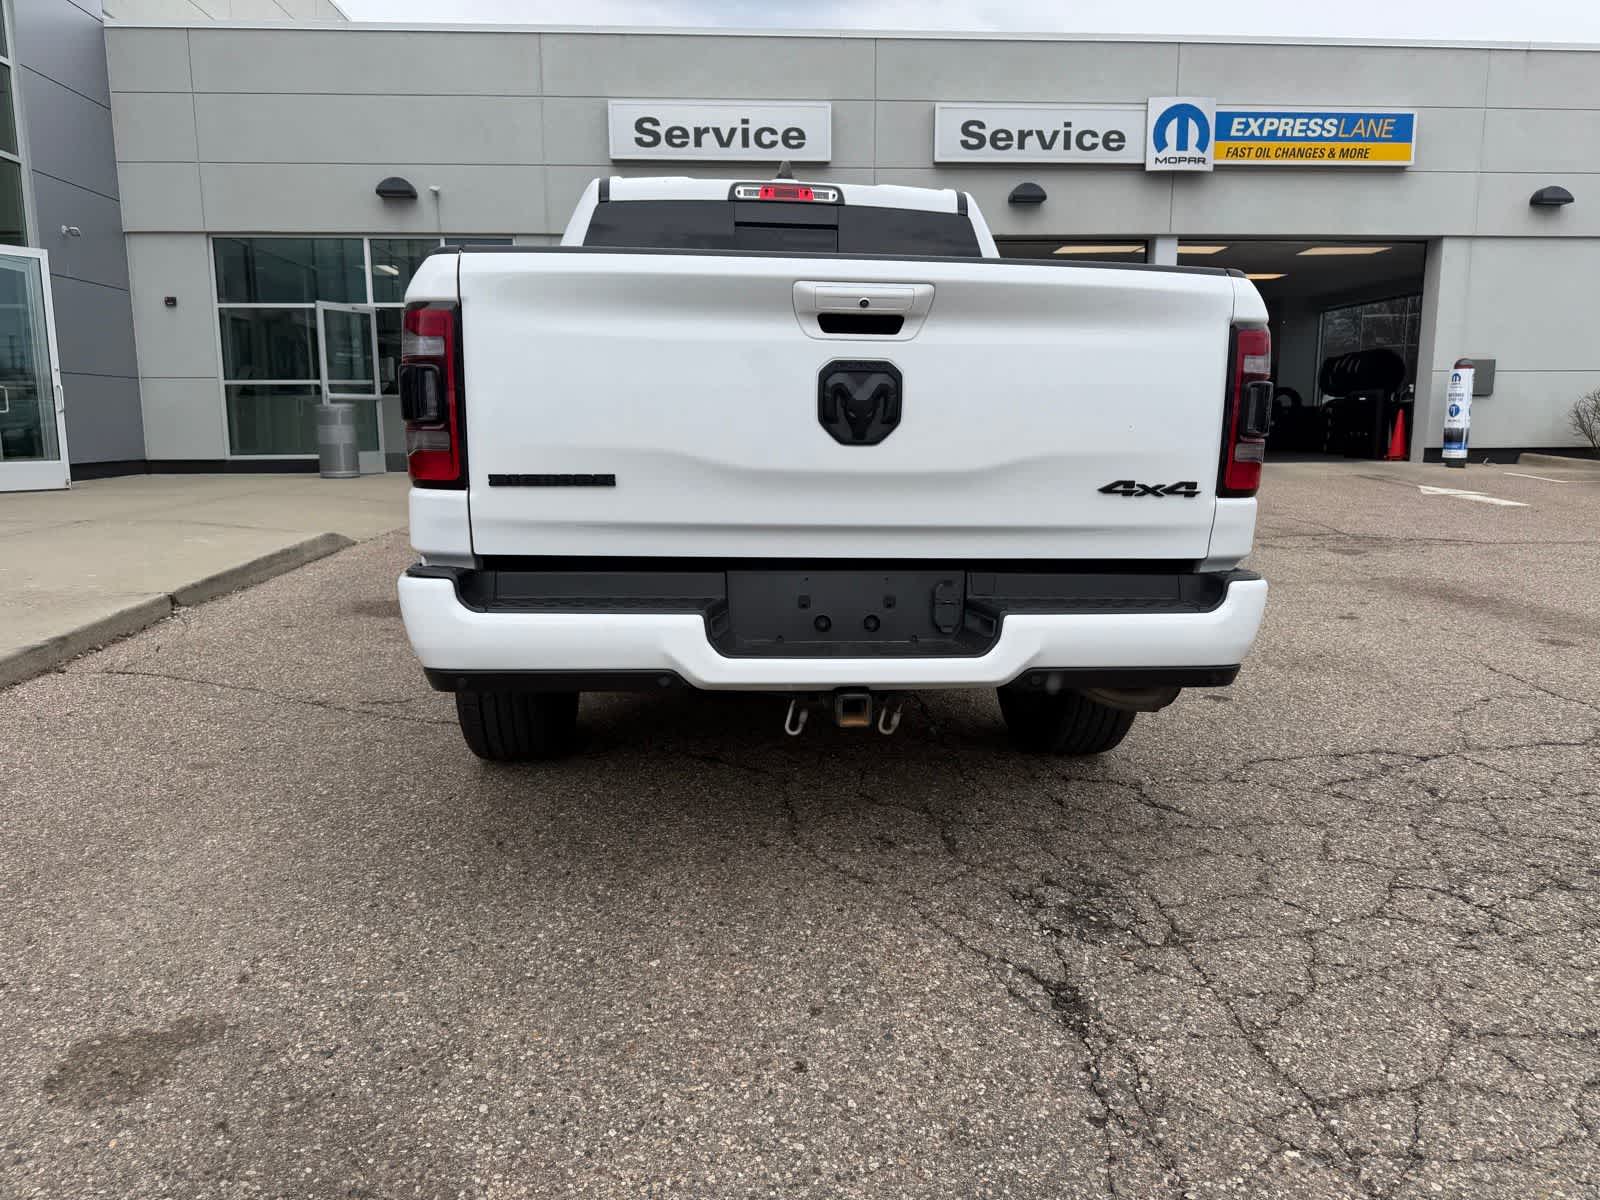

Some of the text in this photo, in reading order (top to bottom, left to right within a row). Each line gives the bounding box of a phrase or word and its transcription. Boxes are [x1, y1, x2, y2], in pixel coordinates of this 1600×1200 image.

[634, 115, 807, 150] Service
[959, 119, 1127, 152] Service
[1154, 156, 1207, 165] MOPAR
[1225, 147, 1371, 161] FAST OIL CHANGES & MORE
[1097, 480, 1202, 498] 4x4
